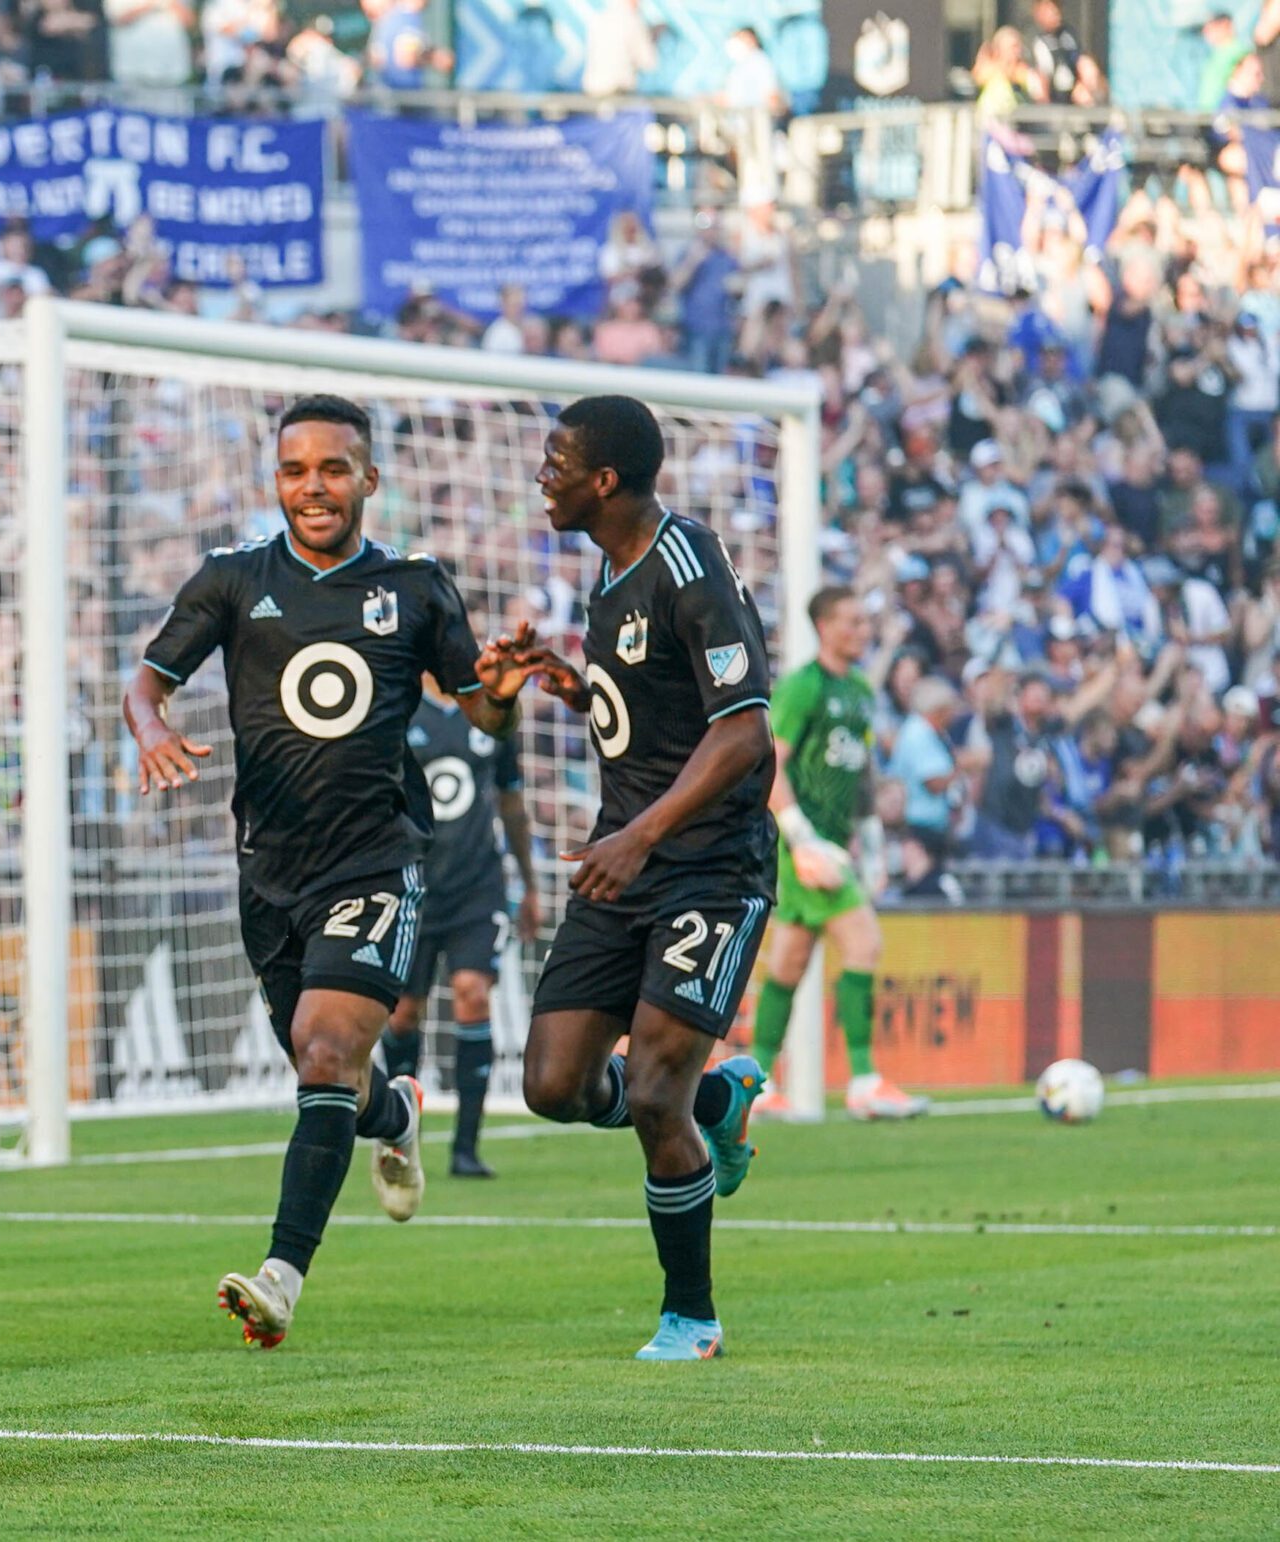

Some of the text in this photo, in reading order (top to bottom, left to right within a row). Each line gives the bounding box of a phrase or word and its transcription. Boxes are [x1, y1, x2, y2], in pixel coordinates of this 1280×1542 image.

[197, 182, 313, 226] MOVED
[323, 891, 400, 943] 27
[662, 910, 734, 981] 21
